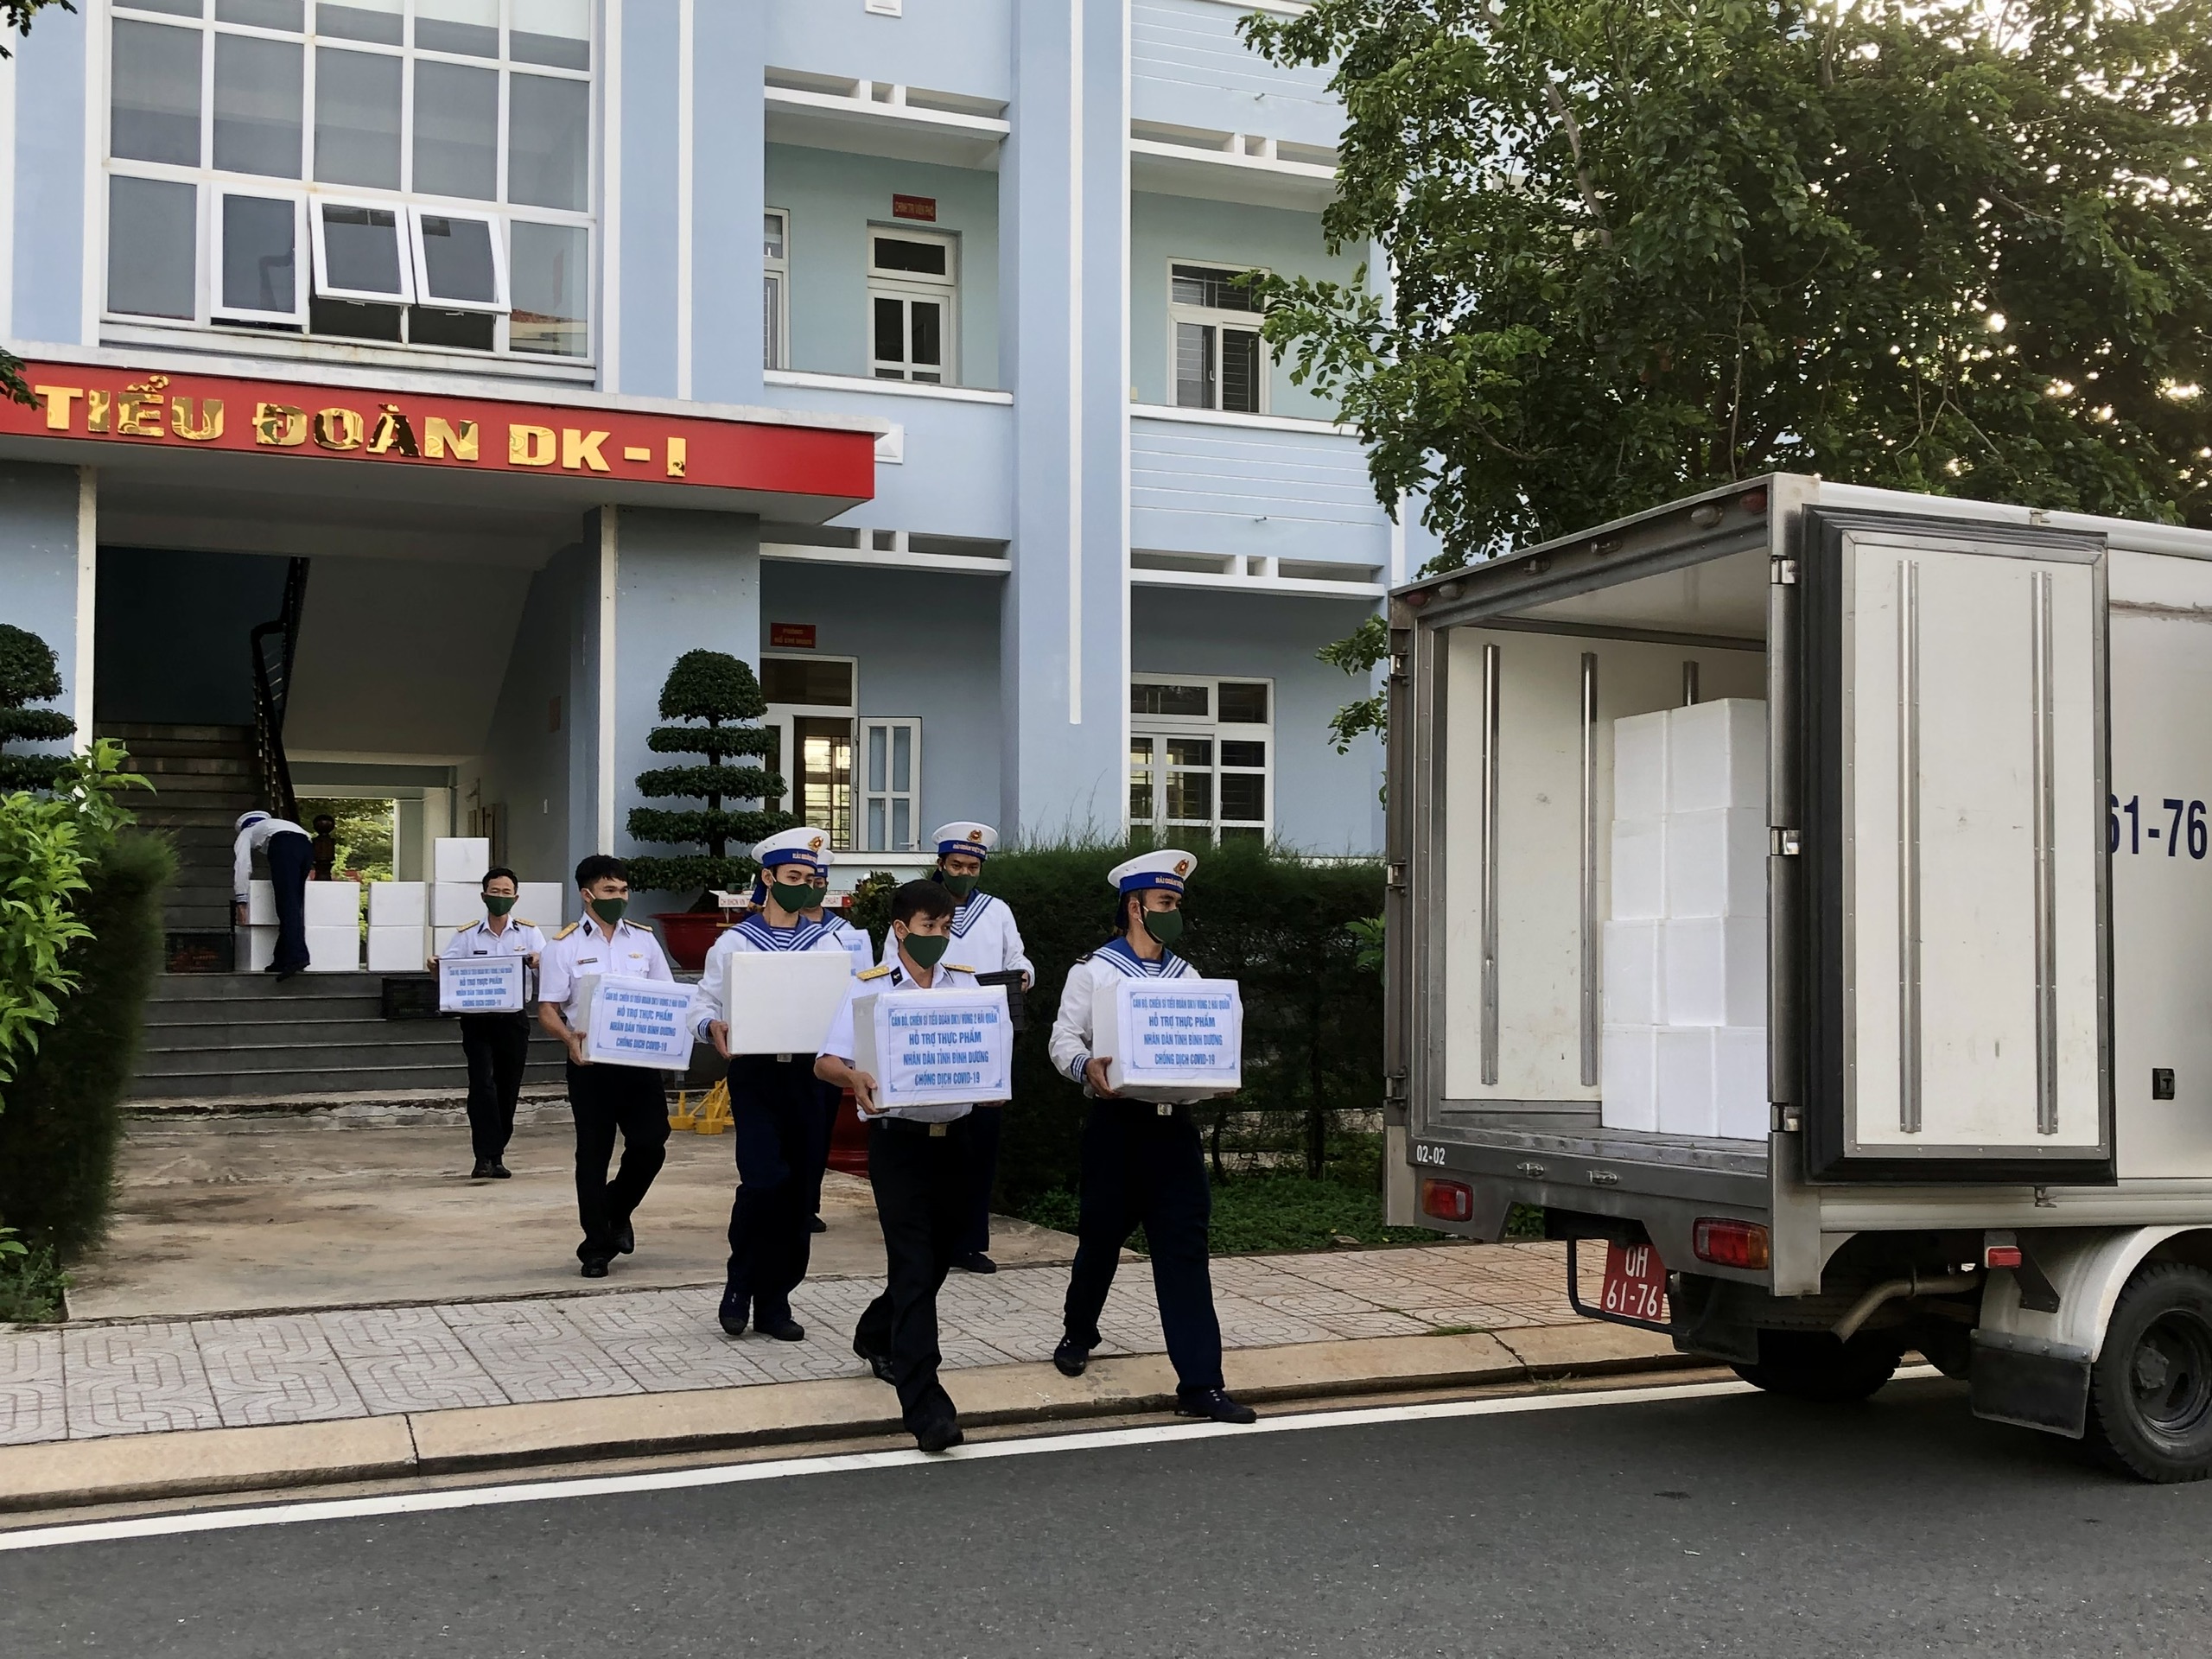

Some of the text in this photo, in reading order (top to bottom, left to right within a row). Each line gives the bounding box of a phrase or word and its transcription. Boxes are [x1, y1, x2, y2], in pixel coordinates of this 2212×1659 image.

[35, 375, 225, 441] TIỂU
[251, 402, 479, 461] ĐOÀN
[1148, 1011, 1216, 1029] HỖ TRỢ THỰC PHẨM
[909, 1027, 982, 1047] HỖ TRỢ THỰC PHẨM
[903, 1047, 988, 1065] NHÂN DÂN TỈNH BÌNH DƯƠNG
[1190, 1053, 1215, 1065] COVID-19
[914, 1069, 980, 1088] CHỐNG DỊCH COVID-19
[1416, 1144, 1446, 1166] 02-02
[1606, 1279, 1658, 1317] 61-76
